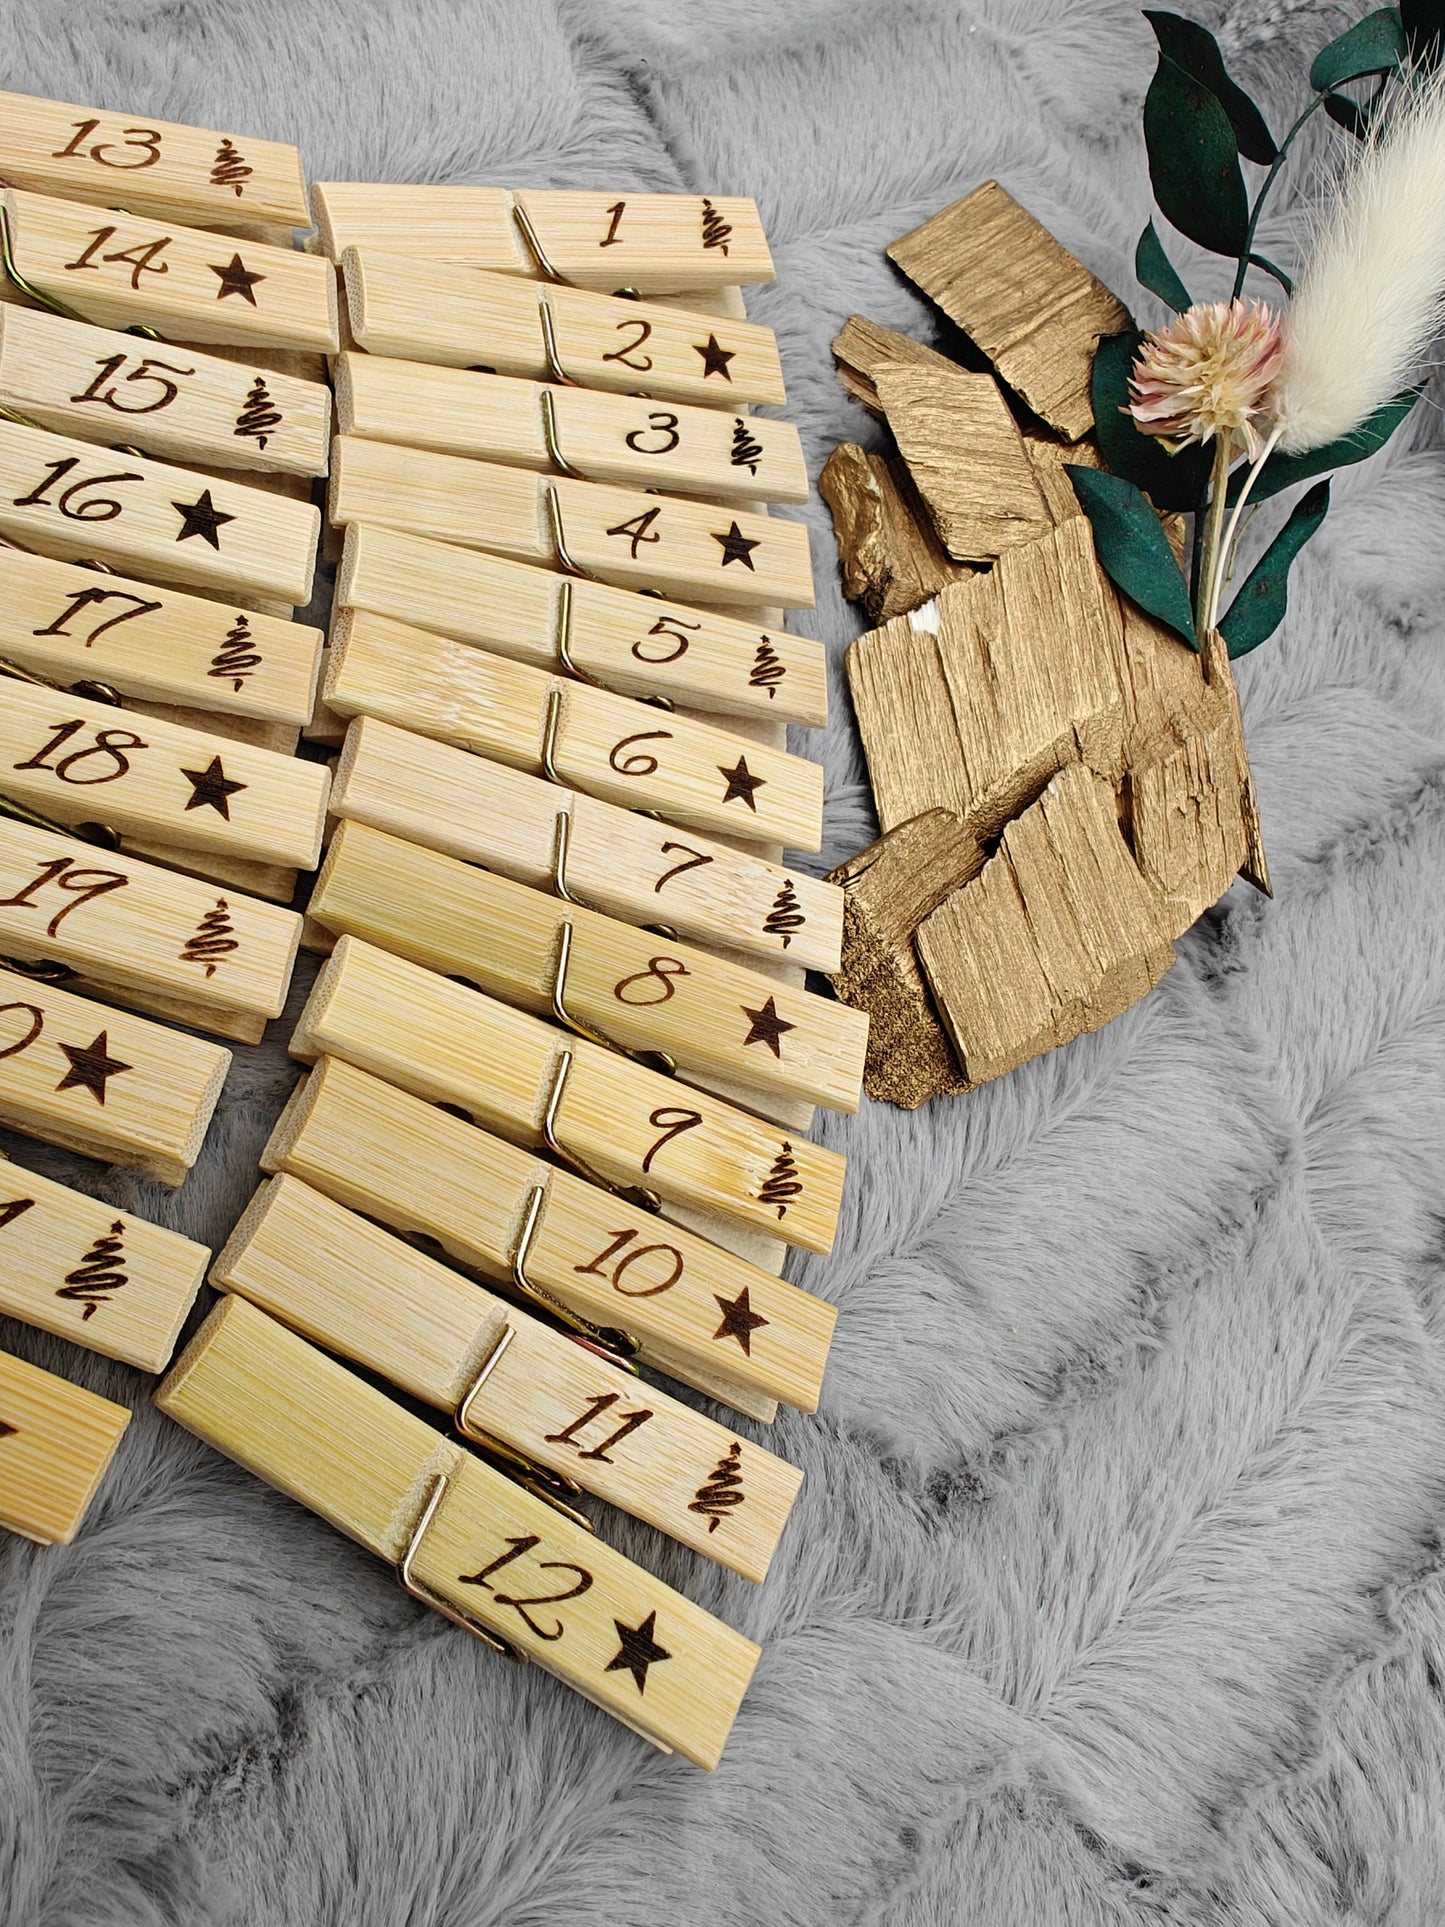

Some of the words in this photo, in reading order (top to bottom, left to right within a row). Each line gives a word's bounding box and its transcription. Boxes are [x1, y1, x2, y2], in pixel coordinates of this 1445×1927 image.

[52, 119, 161, 169] 13
[600, 202, 625, 247] 1
[64, 226, 173, 289] 14
[603, 320, 652, 371] 2
[70, 354, 196, 414] 15
[625, 413, 679, 454] 3
[13, 457, 145, 521] 16
[606, 507, 661, 559] 4
[33, 588, 162, 647] 17
[631, 616, 702, 664] 5
[13, 718, 149, 785] 18
[609, 730, 673, 776] 6
[655, 841, 714, 893] 7
[0, 857, 128, 939] 19
[614, 957, 691, 1006] 8
[642, 1108, 703, 1174] 9
[574, 1227, 685, 1298] 10
[544, 1392, 654, 1465] 11
[458, 1535, 594, 1642] 12
